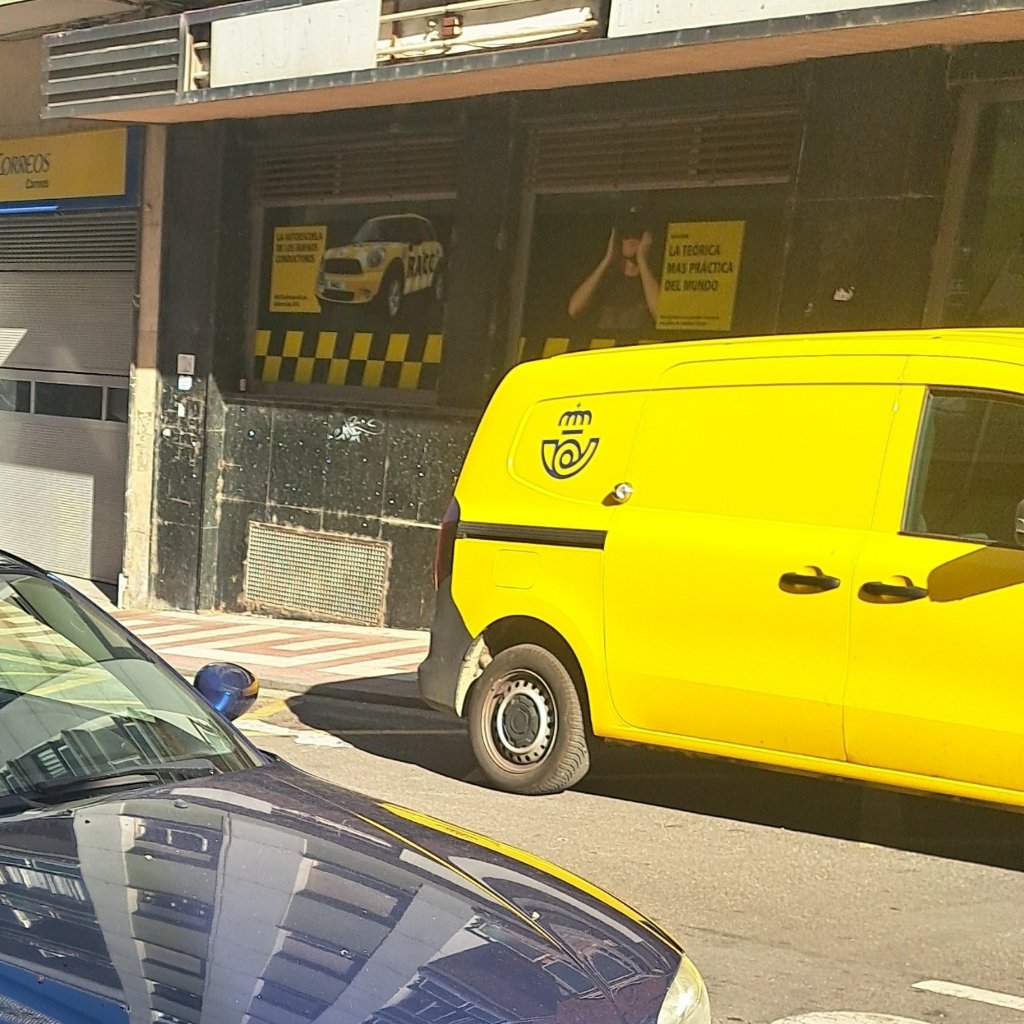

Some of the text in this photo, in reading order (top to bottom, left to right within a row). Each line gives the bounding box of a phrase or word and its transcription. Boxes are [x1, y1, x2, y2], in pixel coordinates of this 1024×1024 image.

[668, 244, 680, 257] LA
[664, 279, 719, 291] DEL MUNDO
